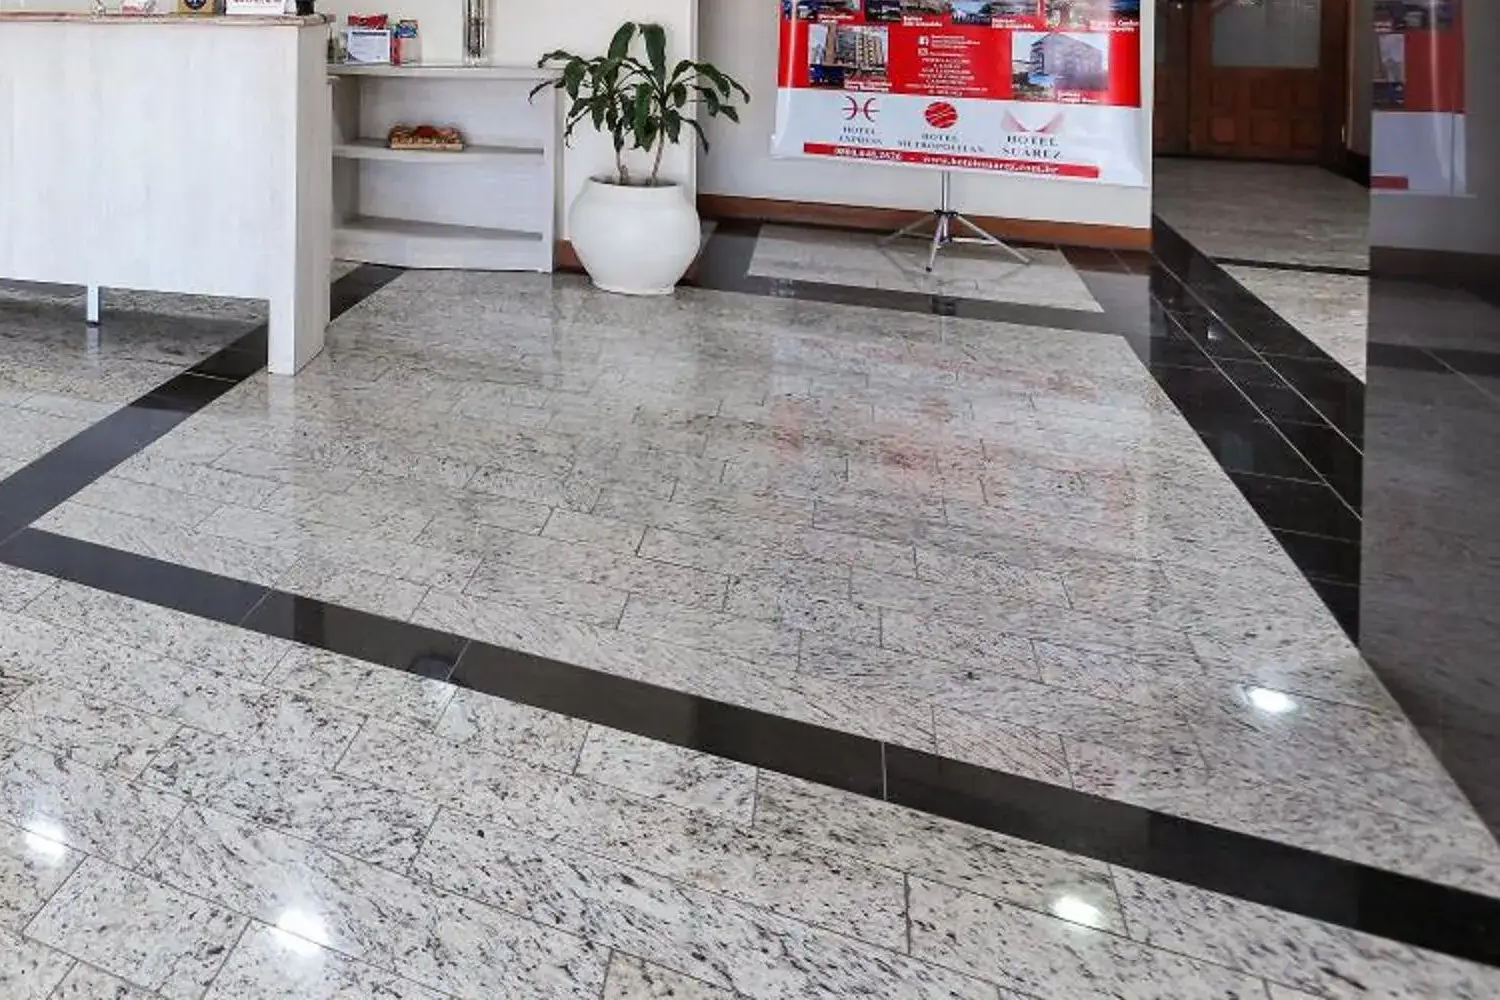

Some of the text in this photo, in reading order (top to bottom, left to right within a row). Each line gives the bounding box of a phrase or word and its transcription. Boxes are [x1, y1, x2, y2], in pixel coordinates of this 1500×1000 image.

[842, 126, 878, 137] HOTEL
[921, 132, 958, 143] HOTEL
[1007, 135, 1059, 147] HOTEL
